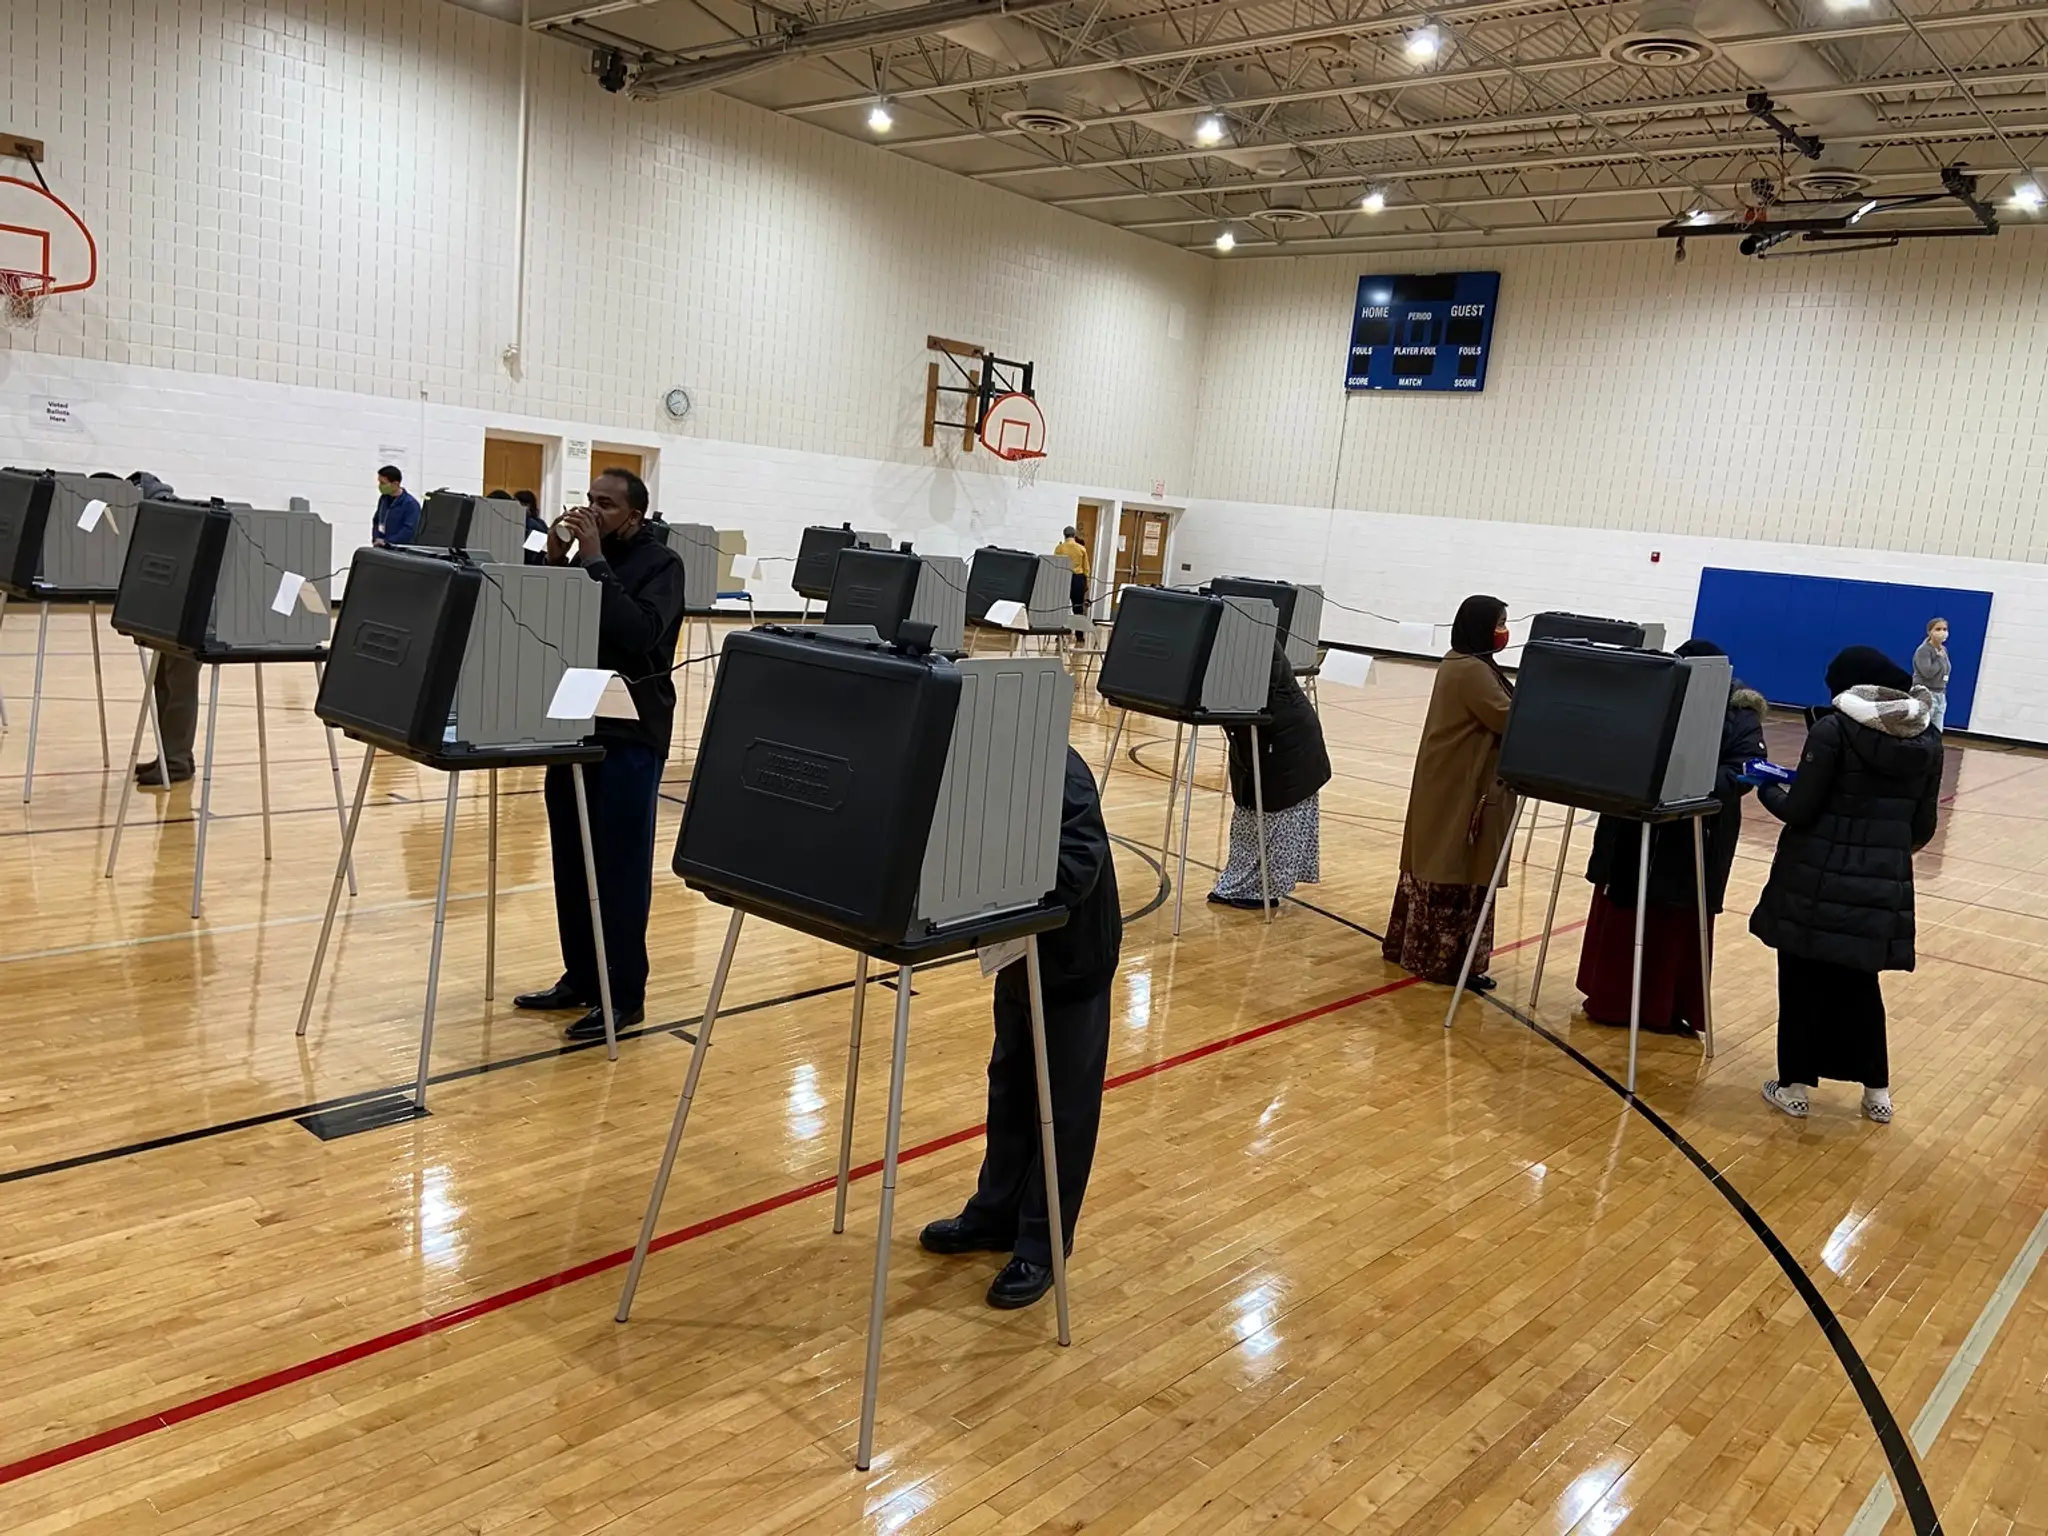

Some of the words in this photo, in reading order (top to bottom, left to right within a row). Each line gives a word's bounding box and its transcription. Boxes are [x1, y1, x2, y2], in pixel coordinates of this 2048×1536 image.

[1361, 306, 1390, 318] HOME
[1450, 304, 1485, 317] GUEST
[1407, 312, 1432, 321] PERIOD
[1351, 346, 1373, 355] FOULS
[1393, 346, 1419, 355] PLAYER
[1420, 346, 1437, 355] FOUL
[1458, 346, 1482, 355] FOULS
[1348, 377, 1369, 386] SCORE
[1398, 378, 1422, 387] MATCH
[1454, 378, 1477, 387] SCORE
